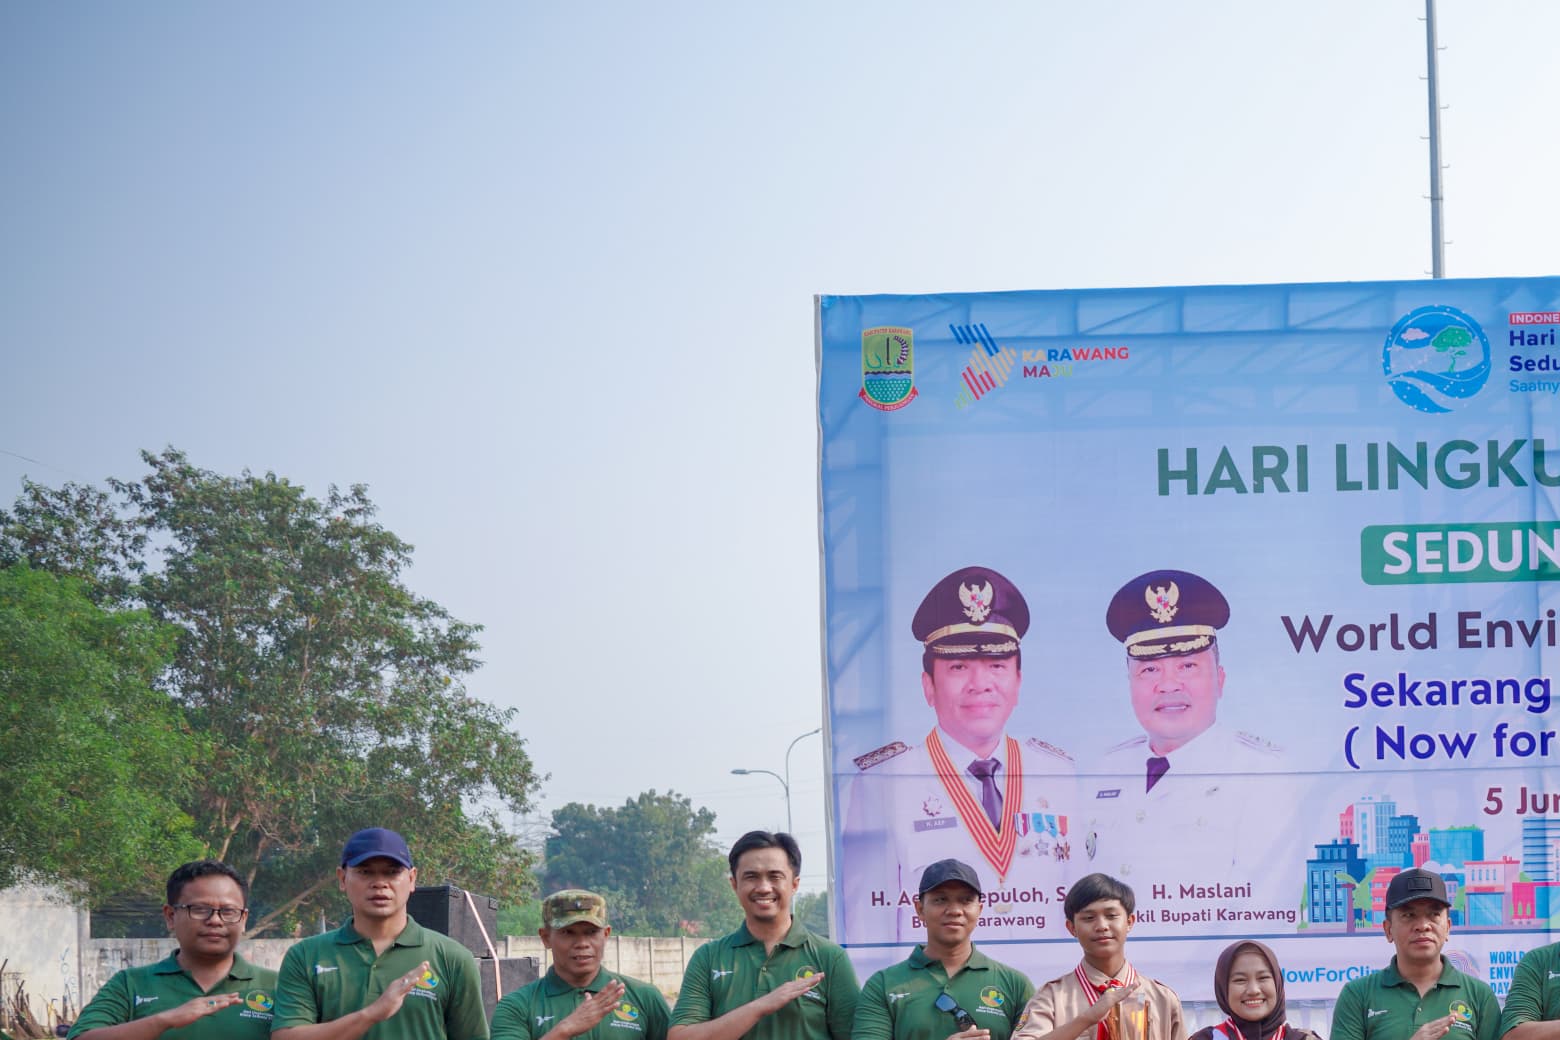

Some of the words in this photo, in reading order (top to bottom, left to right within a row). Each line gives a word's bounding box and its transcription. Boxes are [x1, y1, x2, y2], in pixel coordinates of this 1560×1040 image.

[1509, 329, 1555, 347] Hari
[1022, 347, 1129, 362] KARAWANG
[1023, 364, 1073, 378] MAJU
[1157, 444, 1308, 496] HARI
[1281, 613, 1438, 654] World
[1343, 672, 1551, 713] Sekarang
[1376, 725, 1477, 760] Now
[1493, 723, 1555, 758] for
[1482, 788, 1503, 816] 5
[871, 891, 891, 906] H.
[897, 890, 920, 906] Ae
[980, 887, 1049, 907] epuloh,
[1152, 884, 1172, 899] H.
[1179, 883, 1252, 899] Maslani
[976, 915, 1045, 929] arawang
[1136, 910, 1156, 923] kil
[1161, 909, 1211, 925] Bupati
[1217, 908, 1296, 923] Karawang
[1490, 982, 1510, 994] DAY
